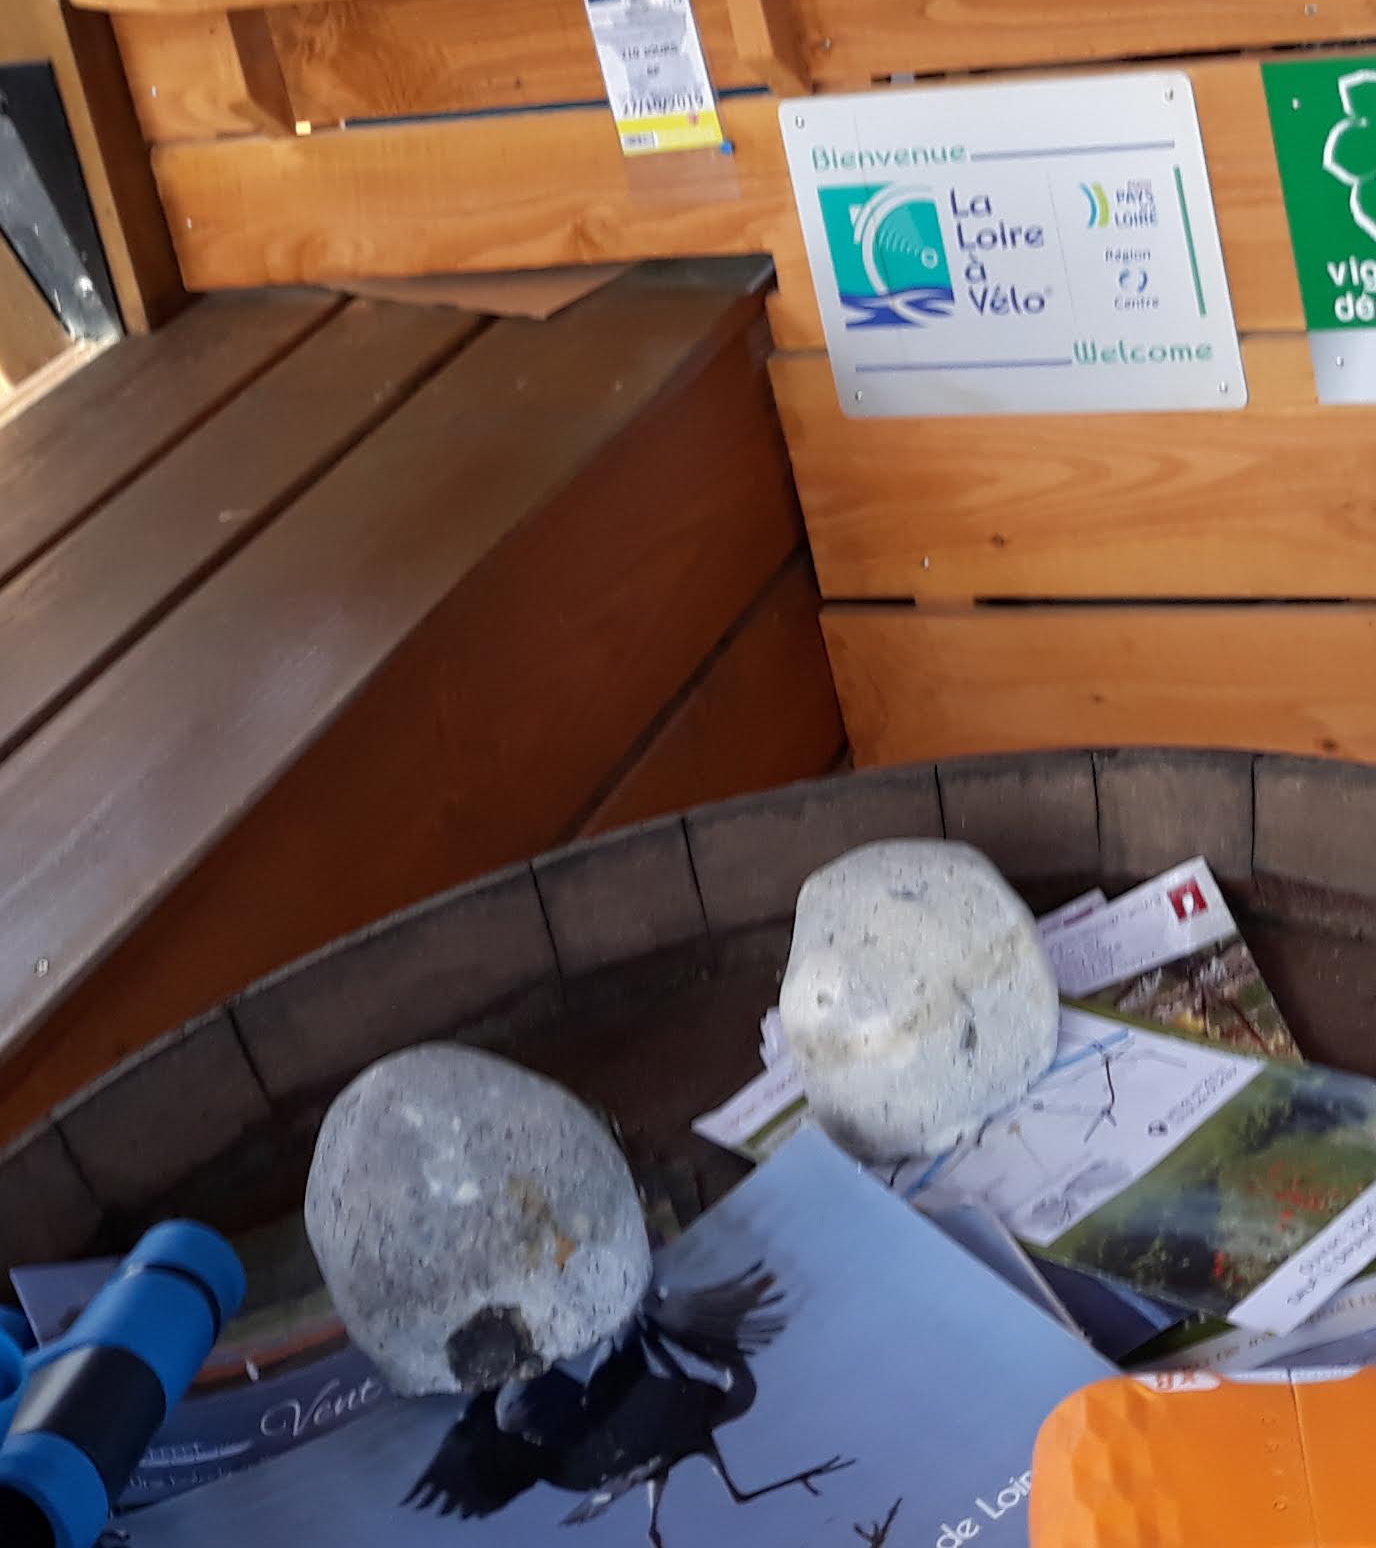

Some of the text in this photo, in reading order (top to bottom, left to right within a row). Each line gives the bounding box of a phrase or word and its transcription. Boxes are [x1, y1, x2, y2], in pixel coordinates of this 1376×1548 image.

[811, 144, 968, 172] Bienvenue
[949, 187, 992, 218] La
[955, 221, 1045, 250] Loire
[964, 255, 987, 286] à
[1072, 338, 1215, 366] Welcome
[935, 1517, 980, 1548] de
